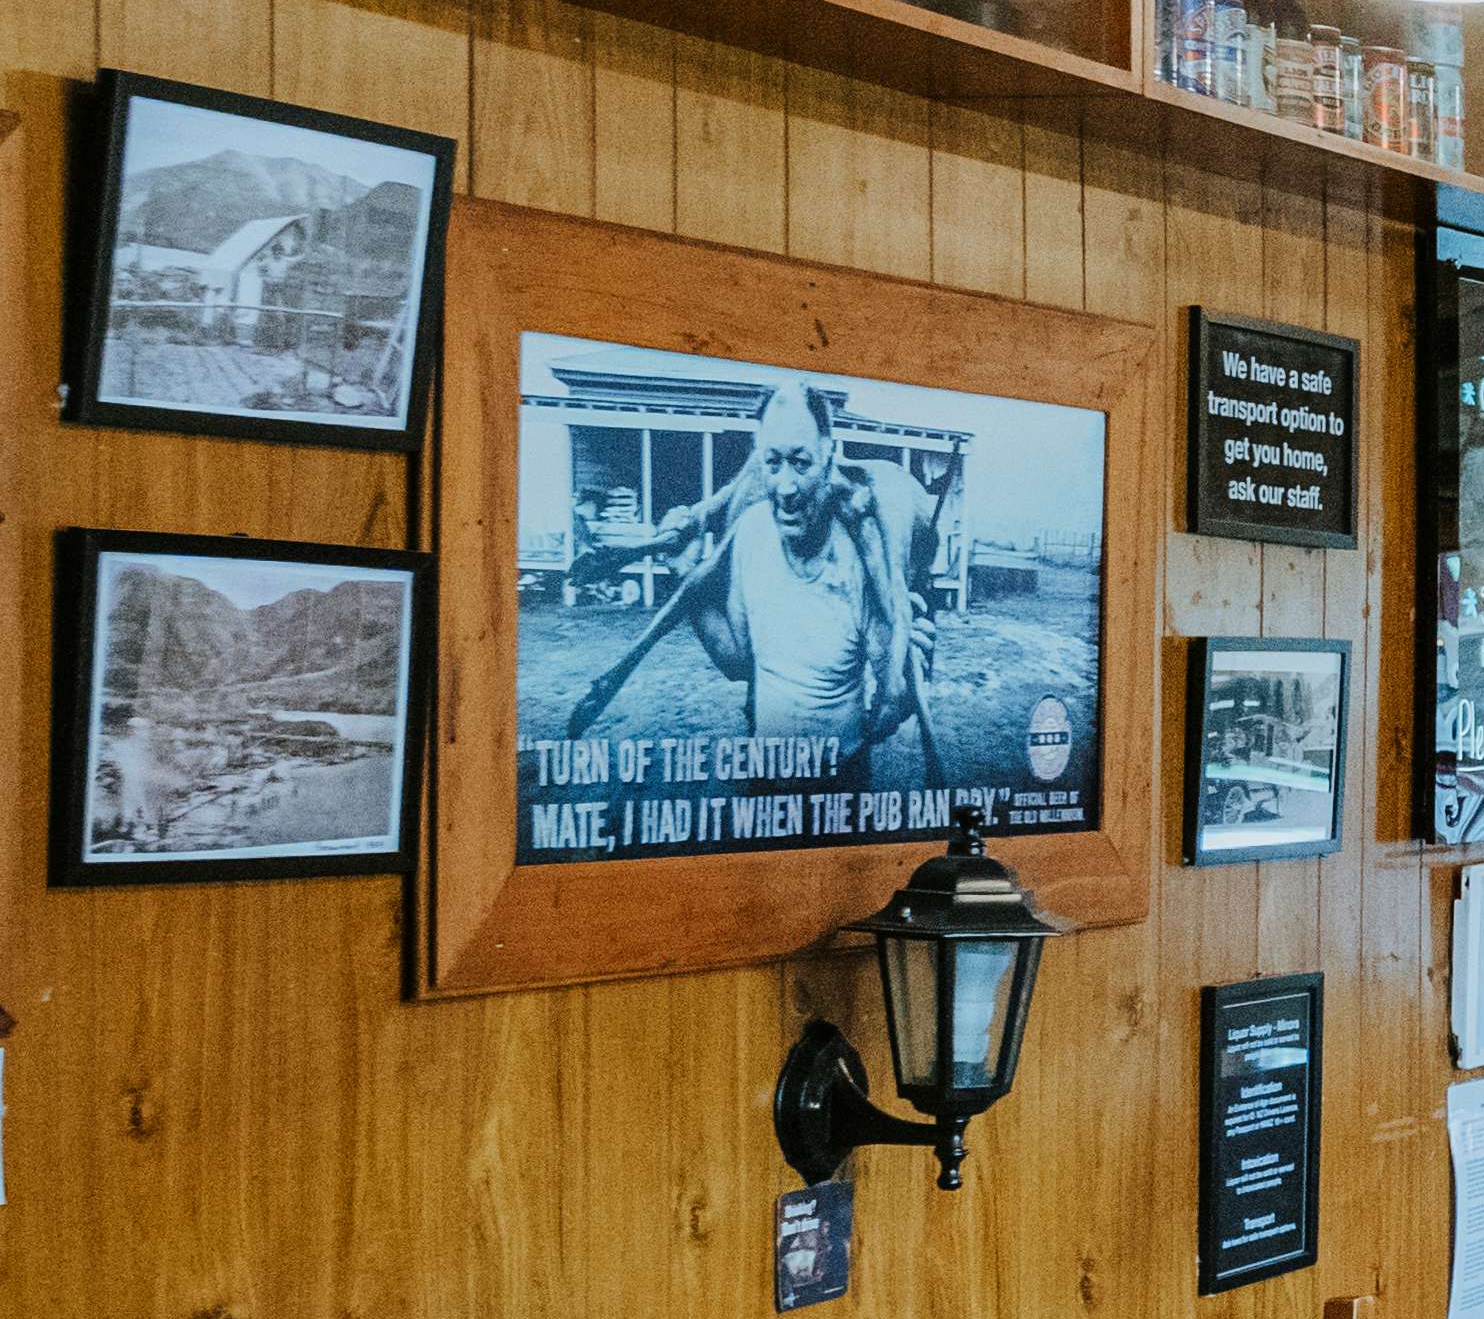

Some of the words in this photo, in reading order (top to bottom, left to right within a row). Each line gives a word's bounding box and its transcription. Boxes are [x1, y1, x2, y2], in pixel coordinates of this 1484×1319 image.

[1222, 350, 1248, 379] We
[1250, 356, 1286, 386] have
[1289, 370, 1298, 389] a
[1301, 370, 1332, 395] safe
[1207, 391, 1278, 426] transport
[1280, 406, 1326, 433] option
[1328, 412, 1344, 437] to
[1224, 437, 1249, 465] get
[1252, 443, 1280, 468] you
[1283, 442, 1328, 477] home,
[1228, 477, 1256, 502] ask
[1259, 484, 1285, 504] our
[1287, 485, 1323, 511] staff.
[618, 738, 654, 783] OF
[660, 737, 709, 782] THE
[715, 735, 840, 782] CENTURY?
[1009, 810, 1023, 824] THE
[1024, 809, 1037, 823] OLD
[1050, 791, 1067, 805] BEER
[1069, 790, 1079, 803] OF
[532, 801, 616, 852] MATE,
[623, 800, 634, 845] I
[640, 798, 692, 845] HAD
[698, 797, 726, 842] IT
[731, 793, 803, 840] WHEN
[809, 792, 854, 835] THE
[859, 790, 903, 833] PUB
[908, 788, 951, 830] RAN
